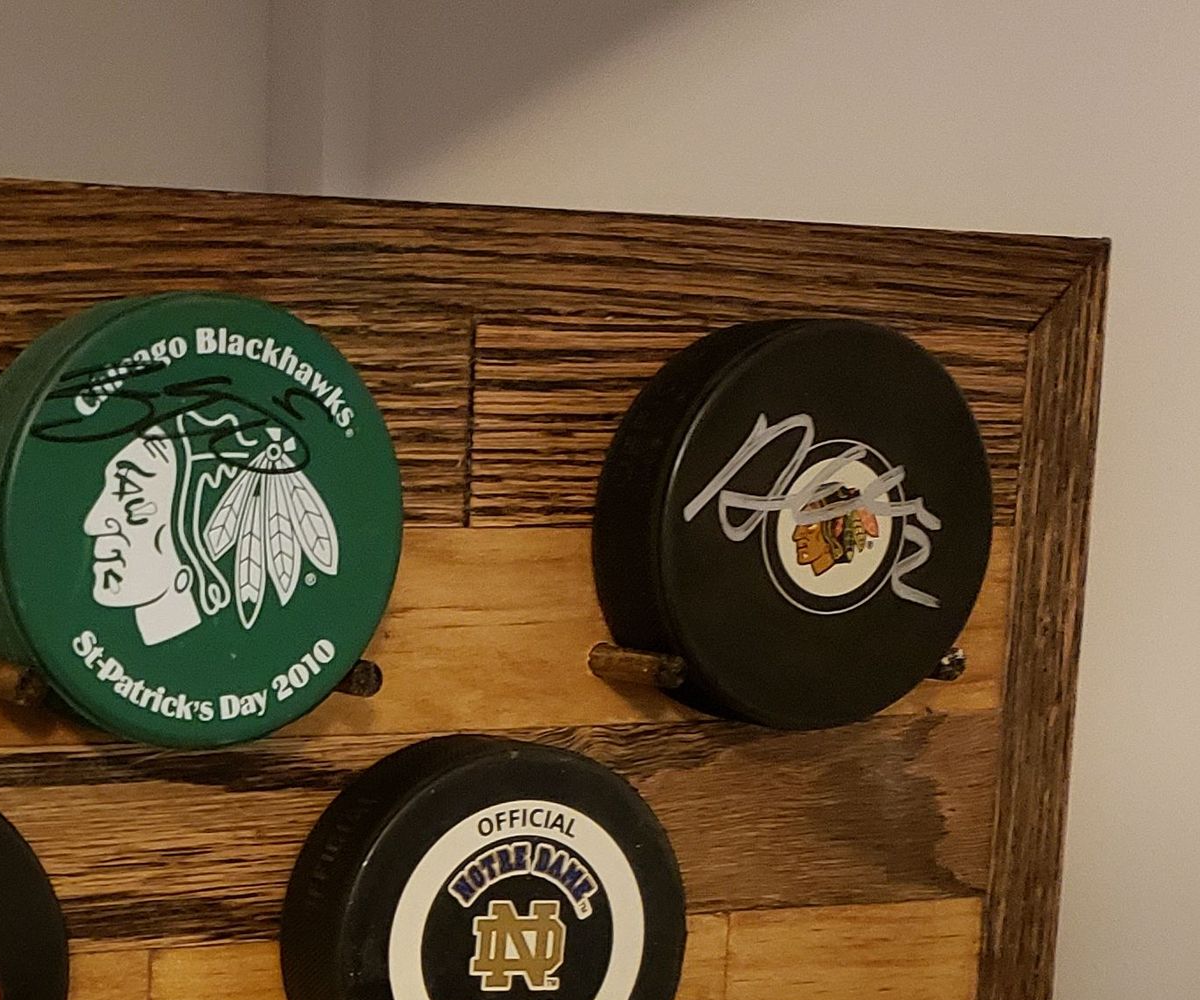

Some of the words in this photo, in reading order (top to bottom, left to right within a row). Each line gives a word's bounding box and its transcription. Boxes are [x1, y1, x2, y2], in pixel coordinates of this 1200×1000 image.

[195, 327, 354, 428] Blackhawks
[219, 689, 268, 720] Day
[271, 639, 335, 701] 2010
[477, 808, 577, 838] OFFICIAL
[448, 841, 532, 907] NOTRE
[532, 843, 598, 904] DAME
